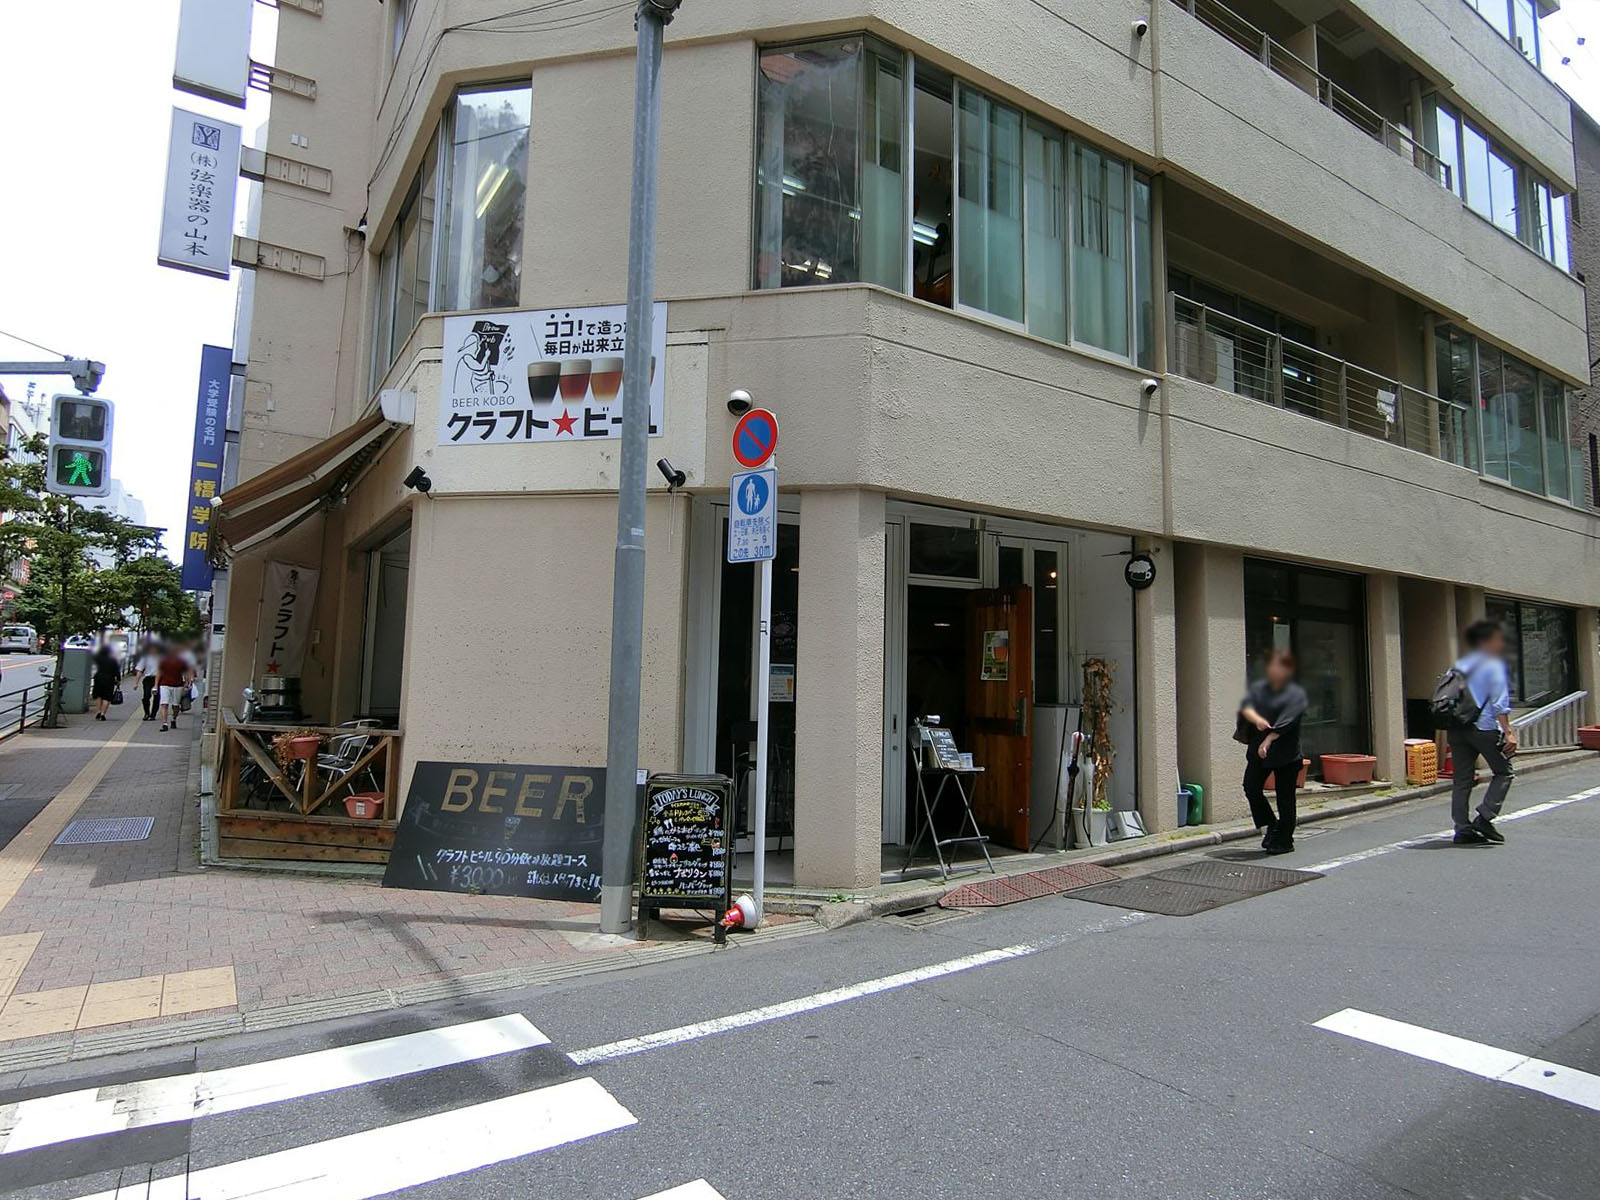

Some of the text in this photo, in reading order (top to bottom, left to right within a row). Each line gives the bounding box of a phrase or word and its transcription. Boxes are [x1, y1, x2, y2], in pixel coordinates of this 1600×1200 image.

[452, 396, 515, 409] BEER KOBO
[189, 461, 219, 551] 一橋学院
[270, 592, 297, 658] クラフト
[440, 768, 594, 824] BEER
